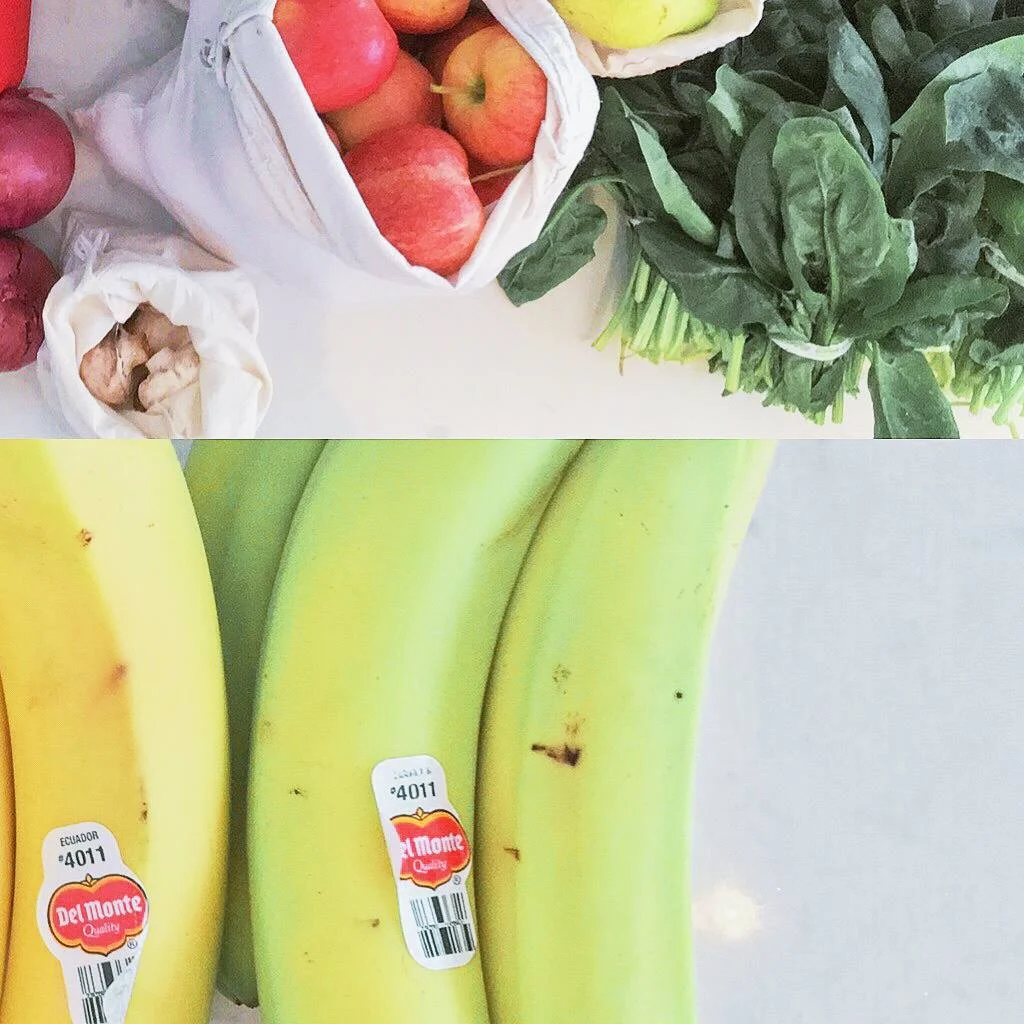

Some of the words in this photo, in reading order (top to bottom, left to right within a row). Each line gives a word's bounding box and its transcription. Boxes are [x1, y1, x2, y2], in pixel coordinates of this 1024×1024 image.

[59, 830, 100, 847] ECUADOR
[414, 833, 465, 857] Monte
[413, 859, 447, 874] Quality
[56, 904, 83, 927] Del
[84, 894, 144, 922] Monte
[82, 922, 121, 938] Quality
